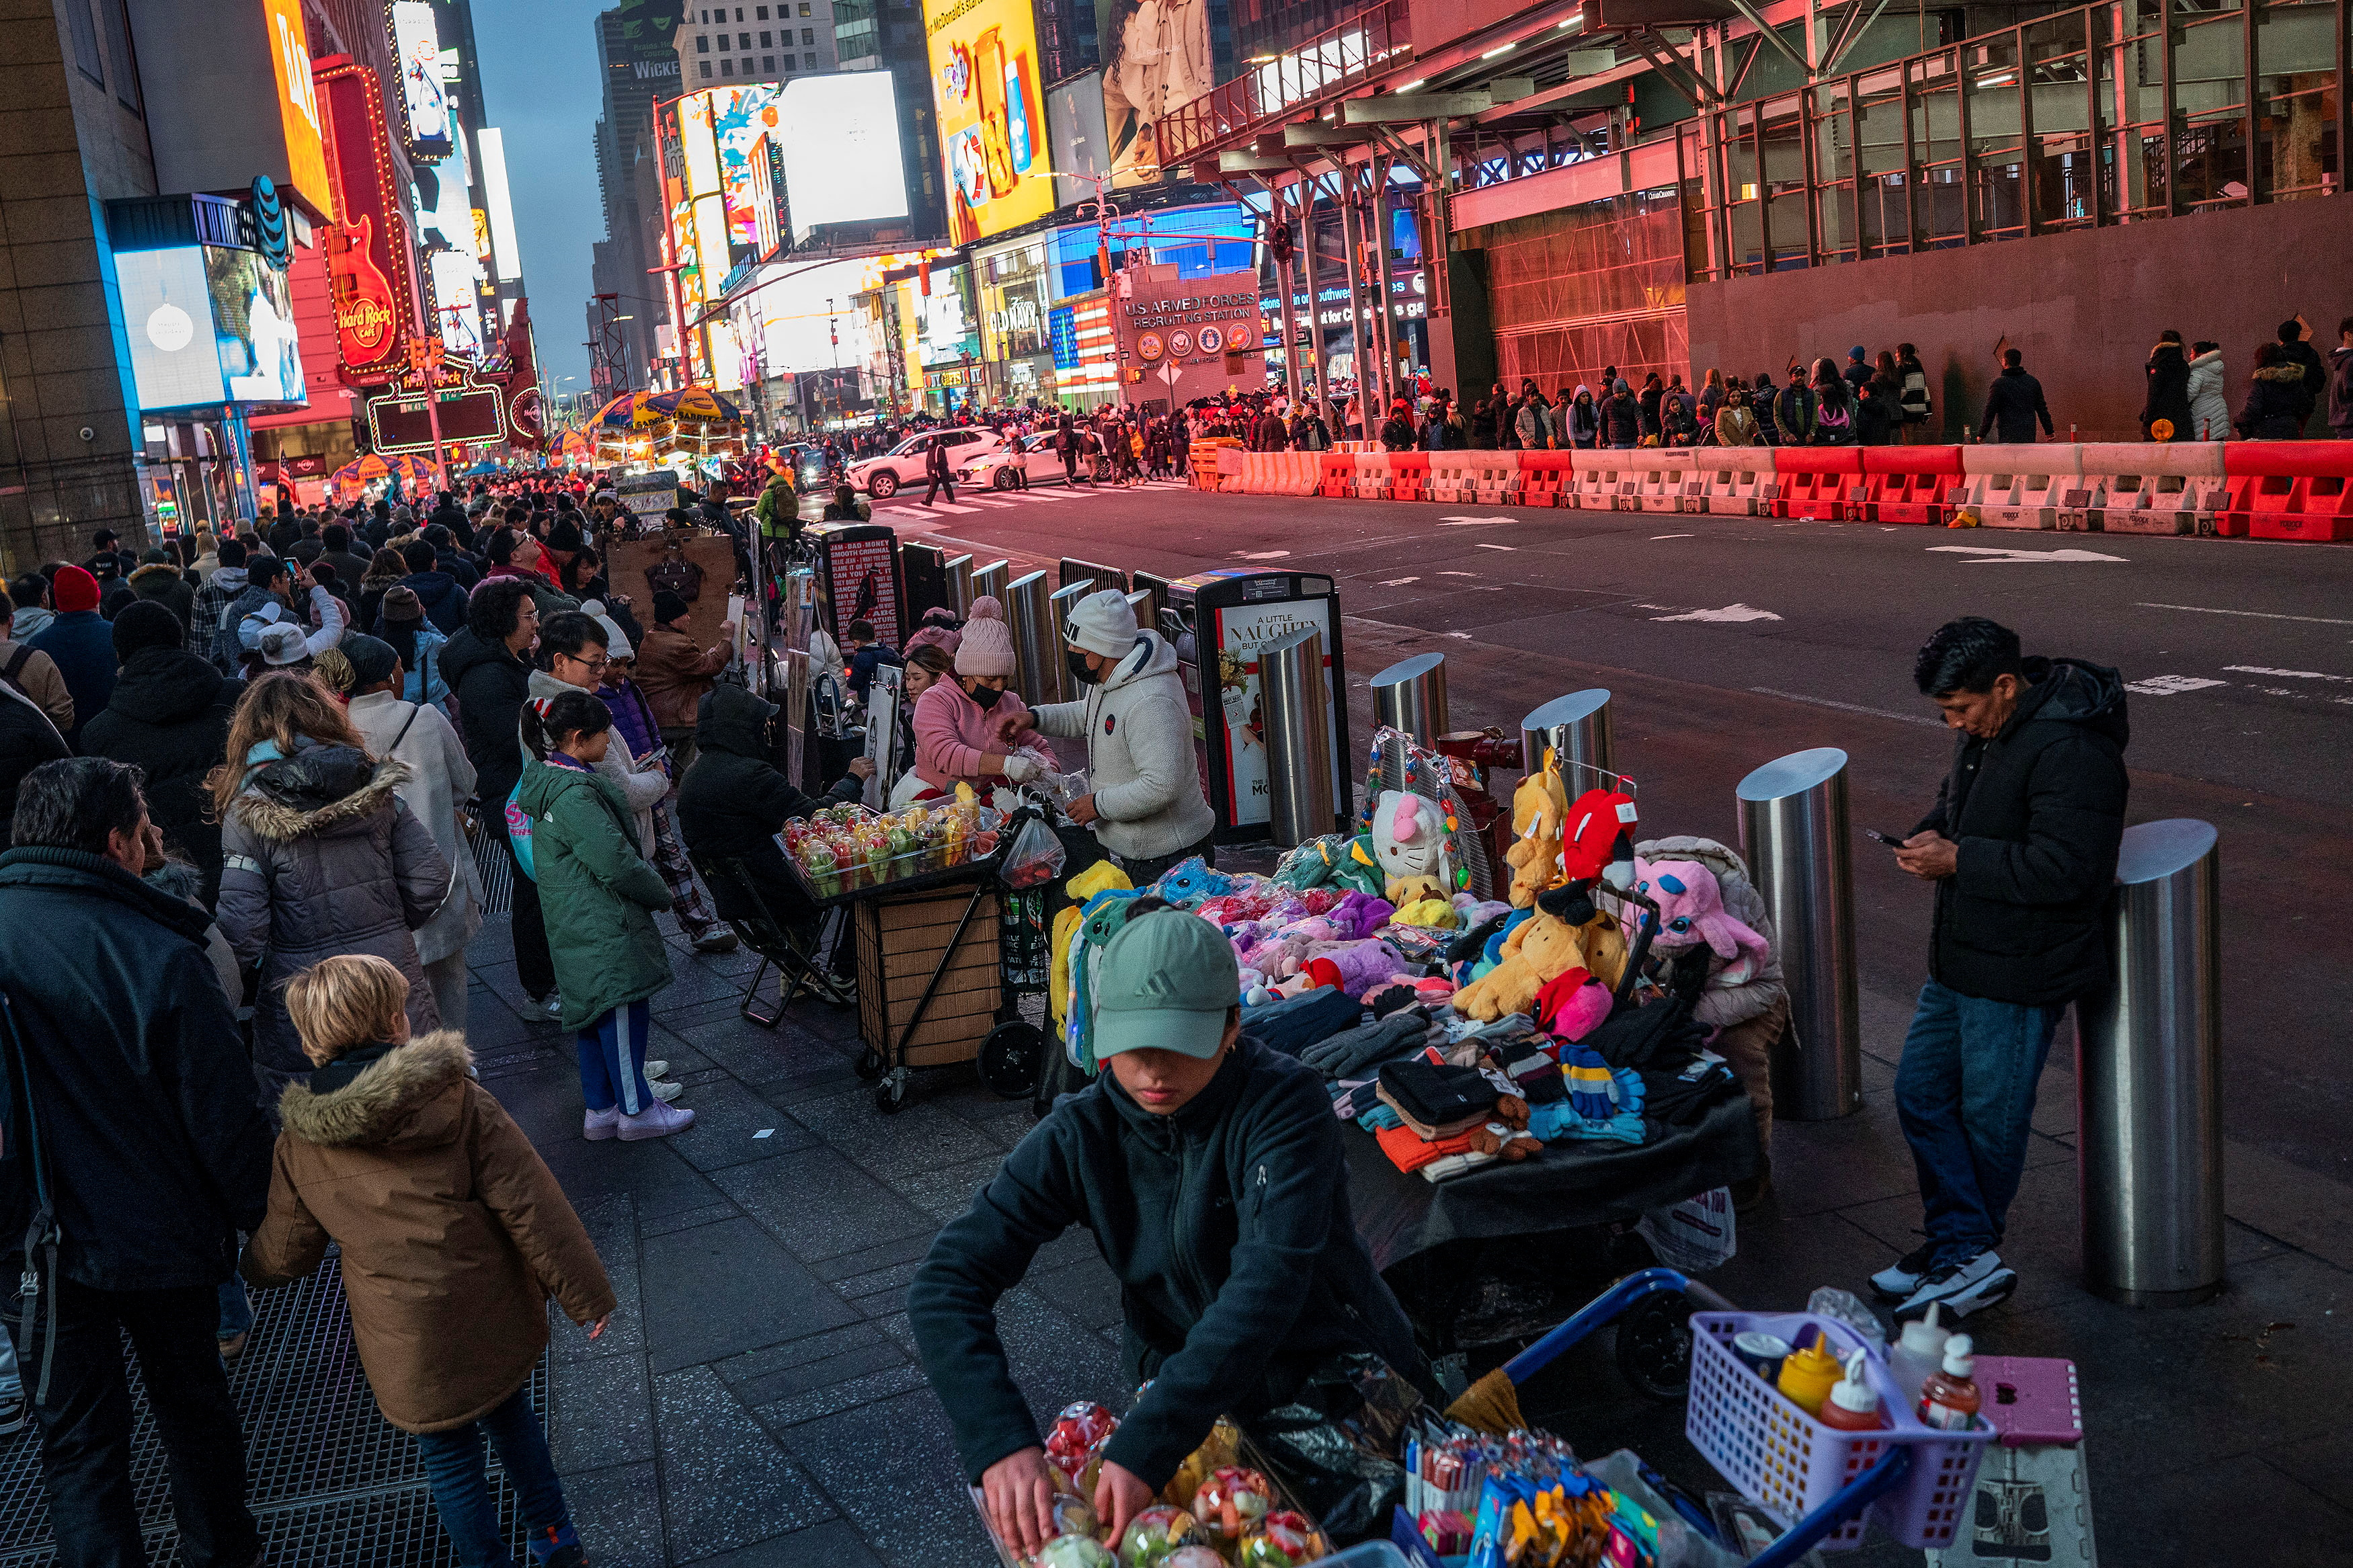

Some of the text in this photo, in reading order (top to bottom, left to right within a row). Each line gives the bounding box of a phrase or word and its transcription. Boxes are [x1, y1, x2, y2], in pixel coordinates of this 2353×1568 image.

[1125, 292, 1256, 317] U.S. ARMED FORCES
[340, 304, 392, 329] Hard Rock
[1009, 302, 1036, 331] NAVY
[1133, 307, 1250, 329] RECRUITING STATION
[360, 328, 376, 338] CAFE
[666, 358, 673, 367] 43
[413, 403, 421, 411] 43
[865, 540, 889, 548] MONEY
[831, 547, 890, 558] SMOOTH CRIMINAL
[873, 609, 895, 617] ABC
[1266, 614, 1293, 623] LITTLE
[1242, 642, 1259, 650] BUT
